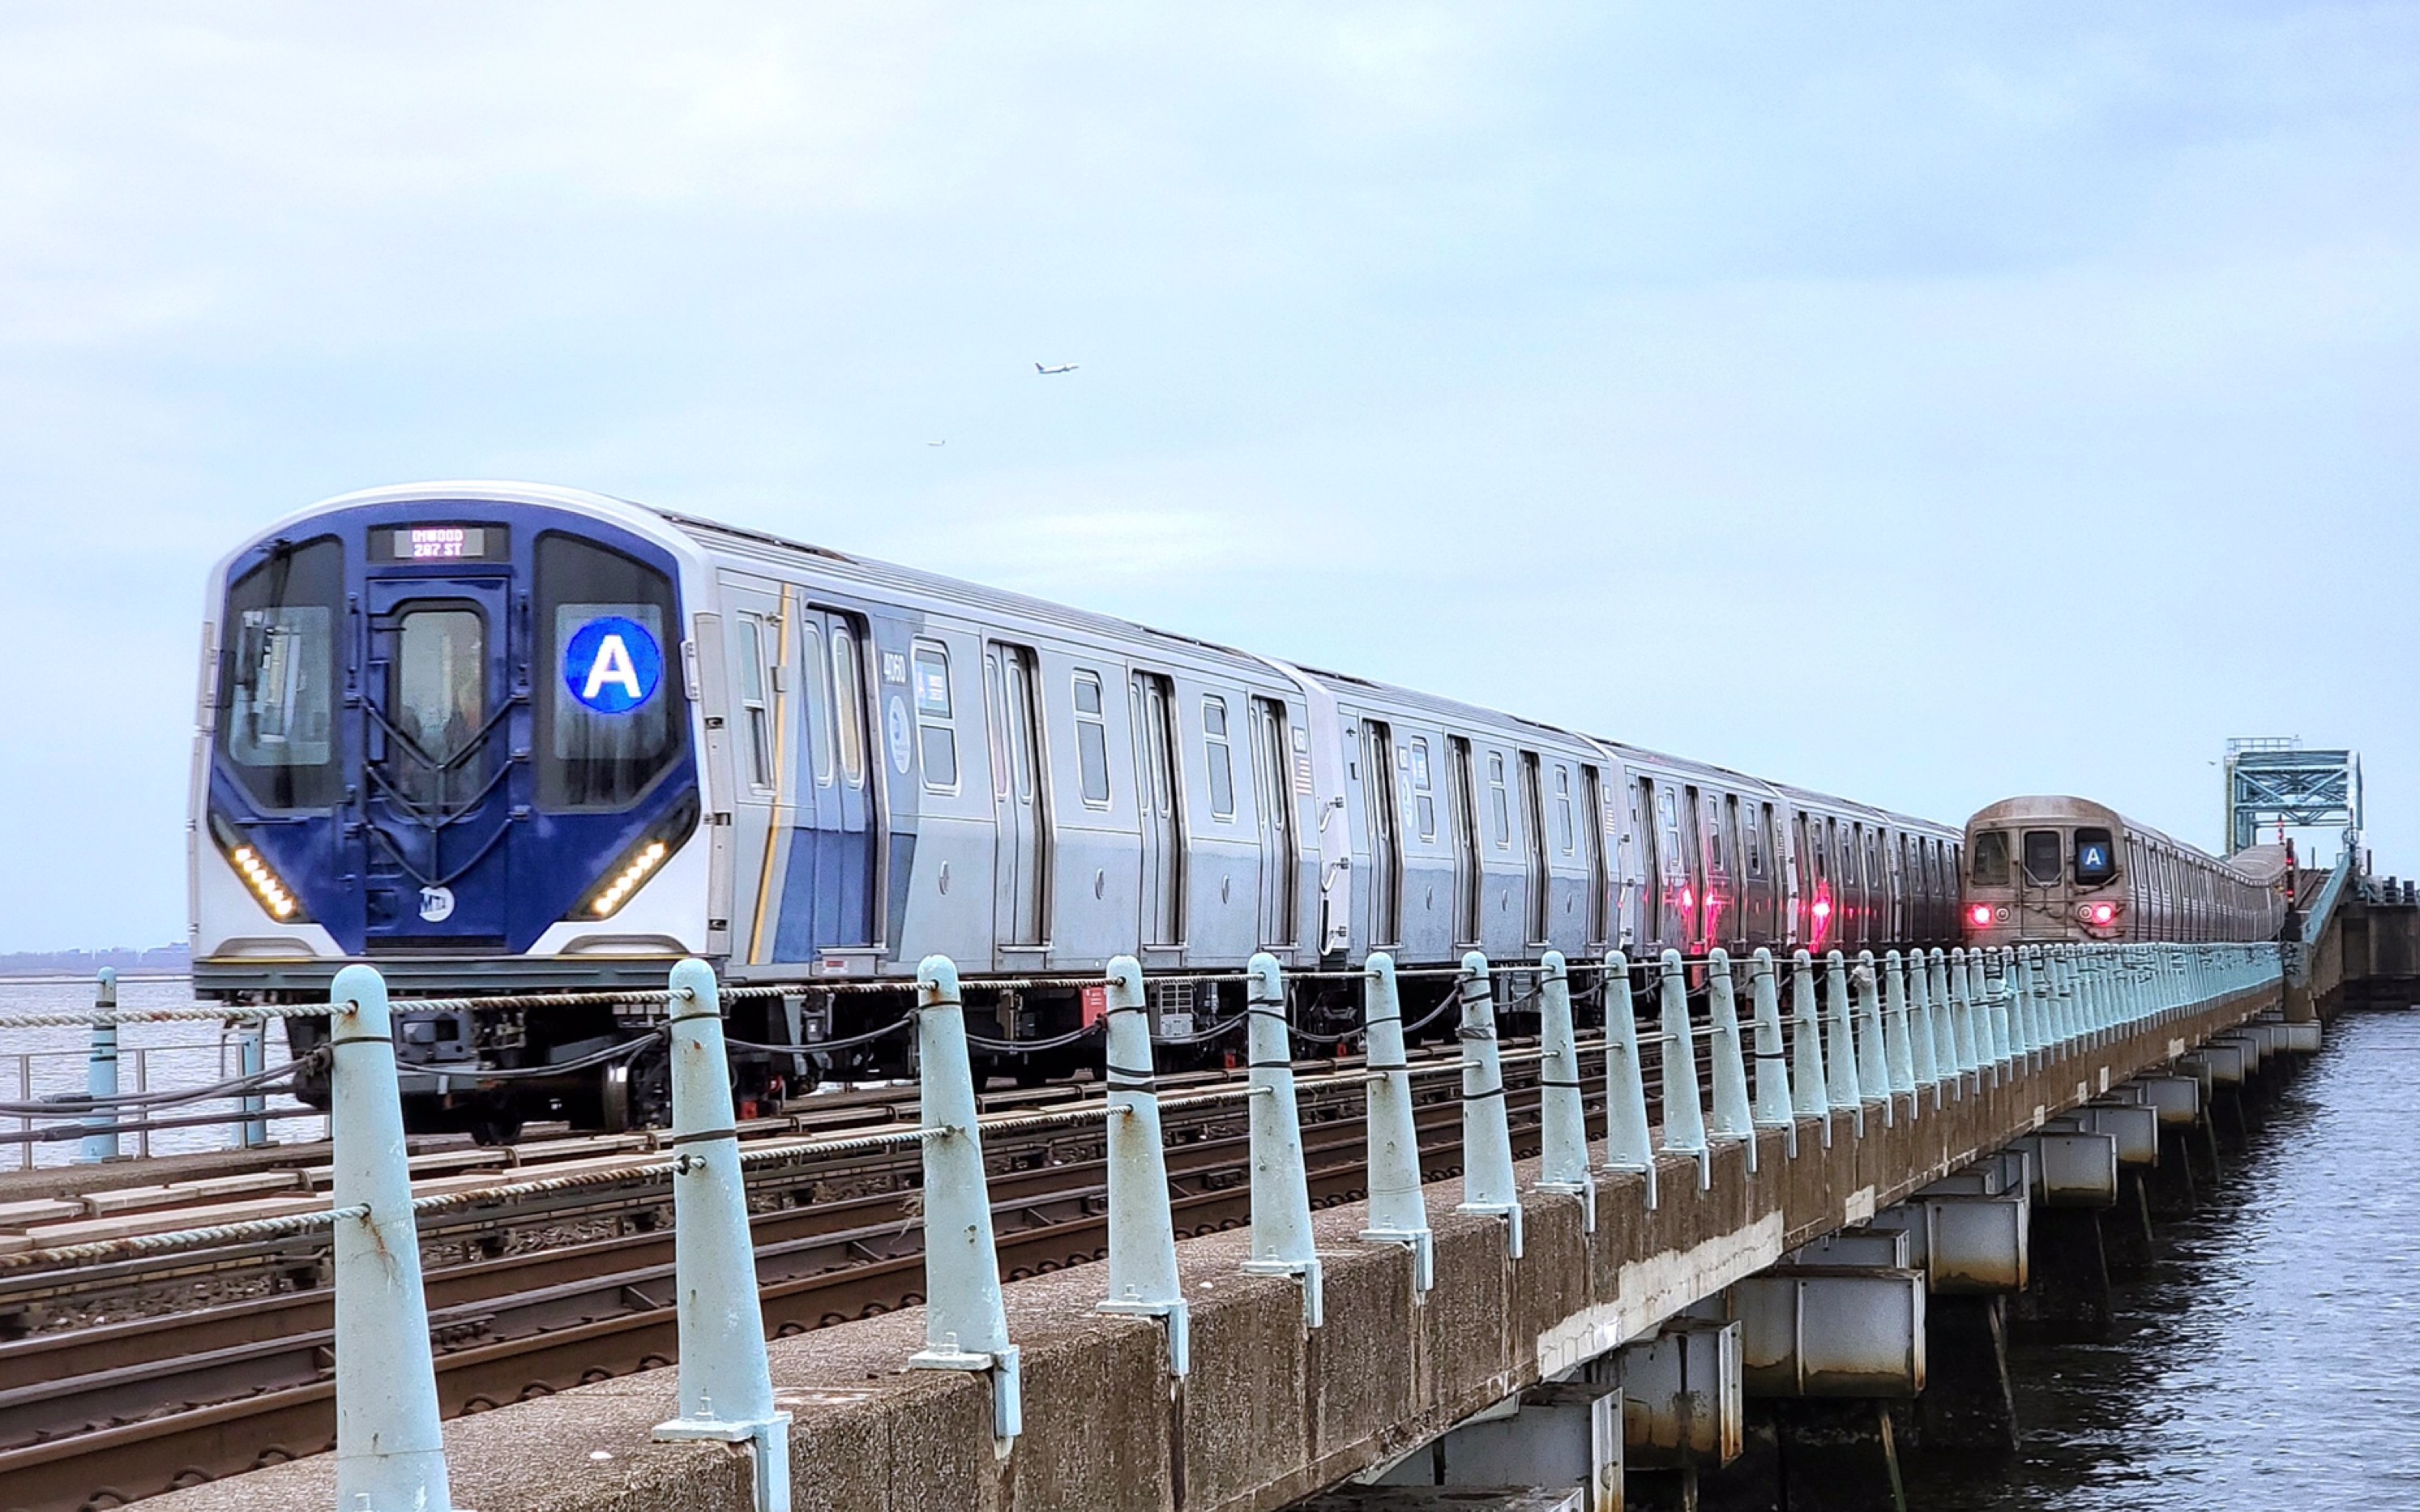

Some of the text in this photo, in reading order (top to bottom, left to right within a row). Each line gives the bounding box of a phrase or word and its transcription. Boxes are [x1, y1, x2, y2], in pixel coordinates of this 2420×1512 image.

[444, 543, 463, 556] ST
[582, 634, 642, 698] A
[2085, 848, 2101, 865] A
